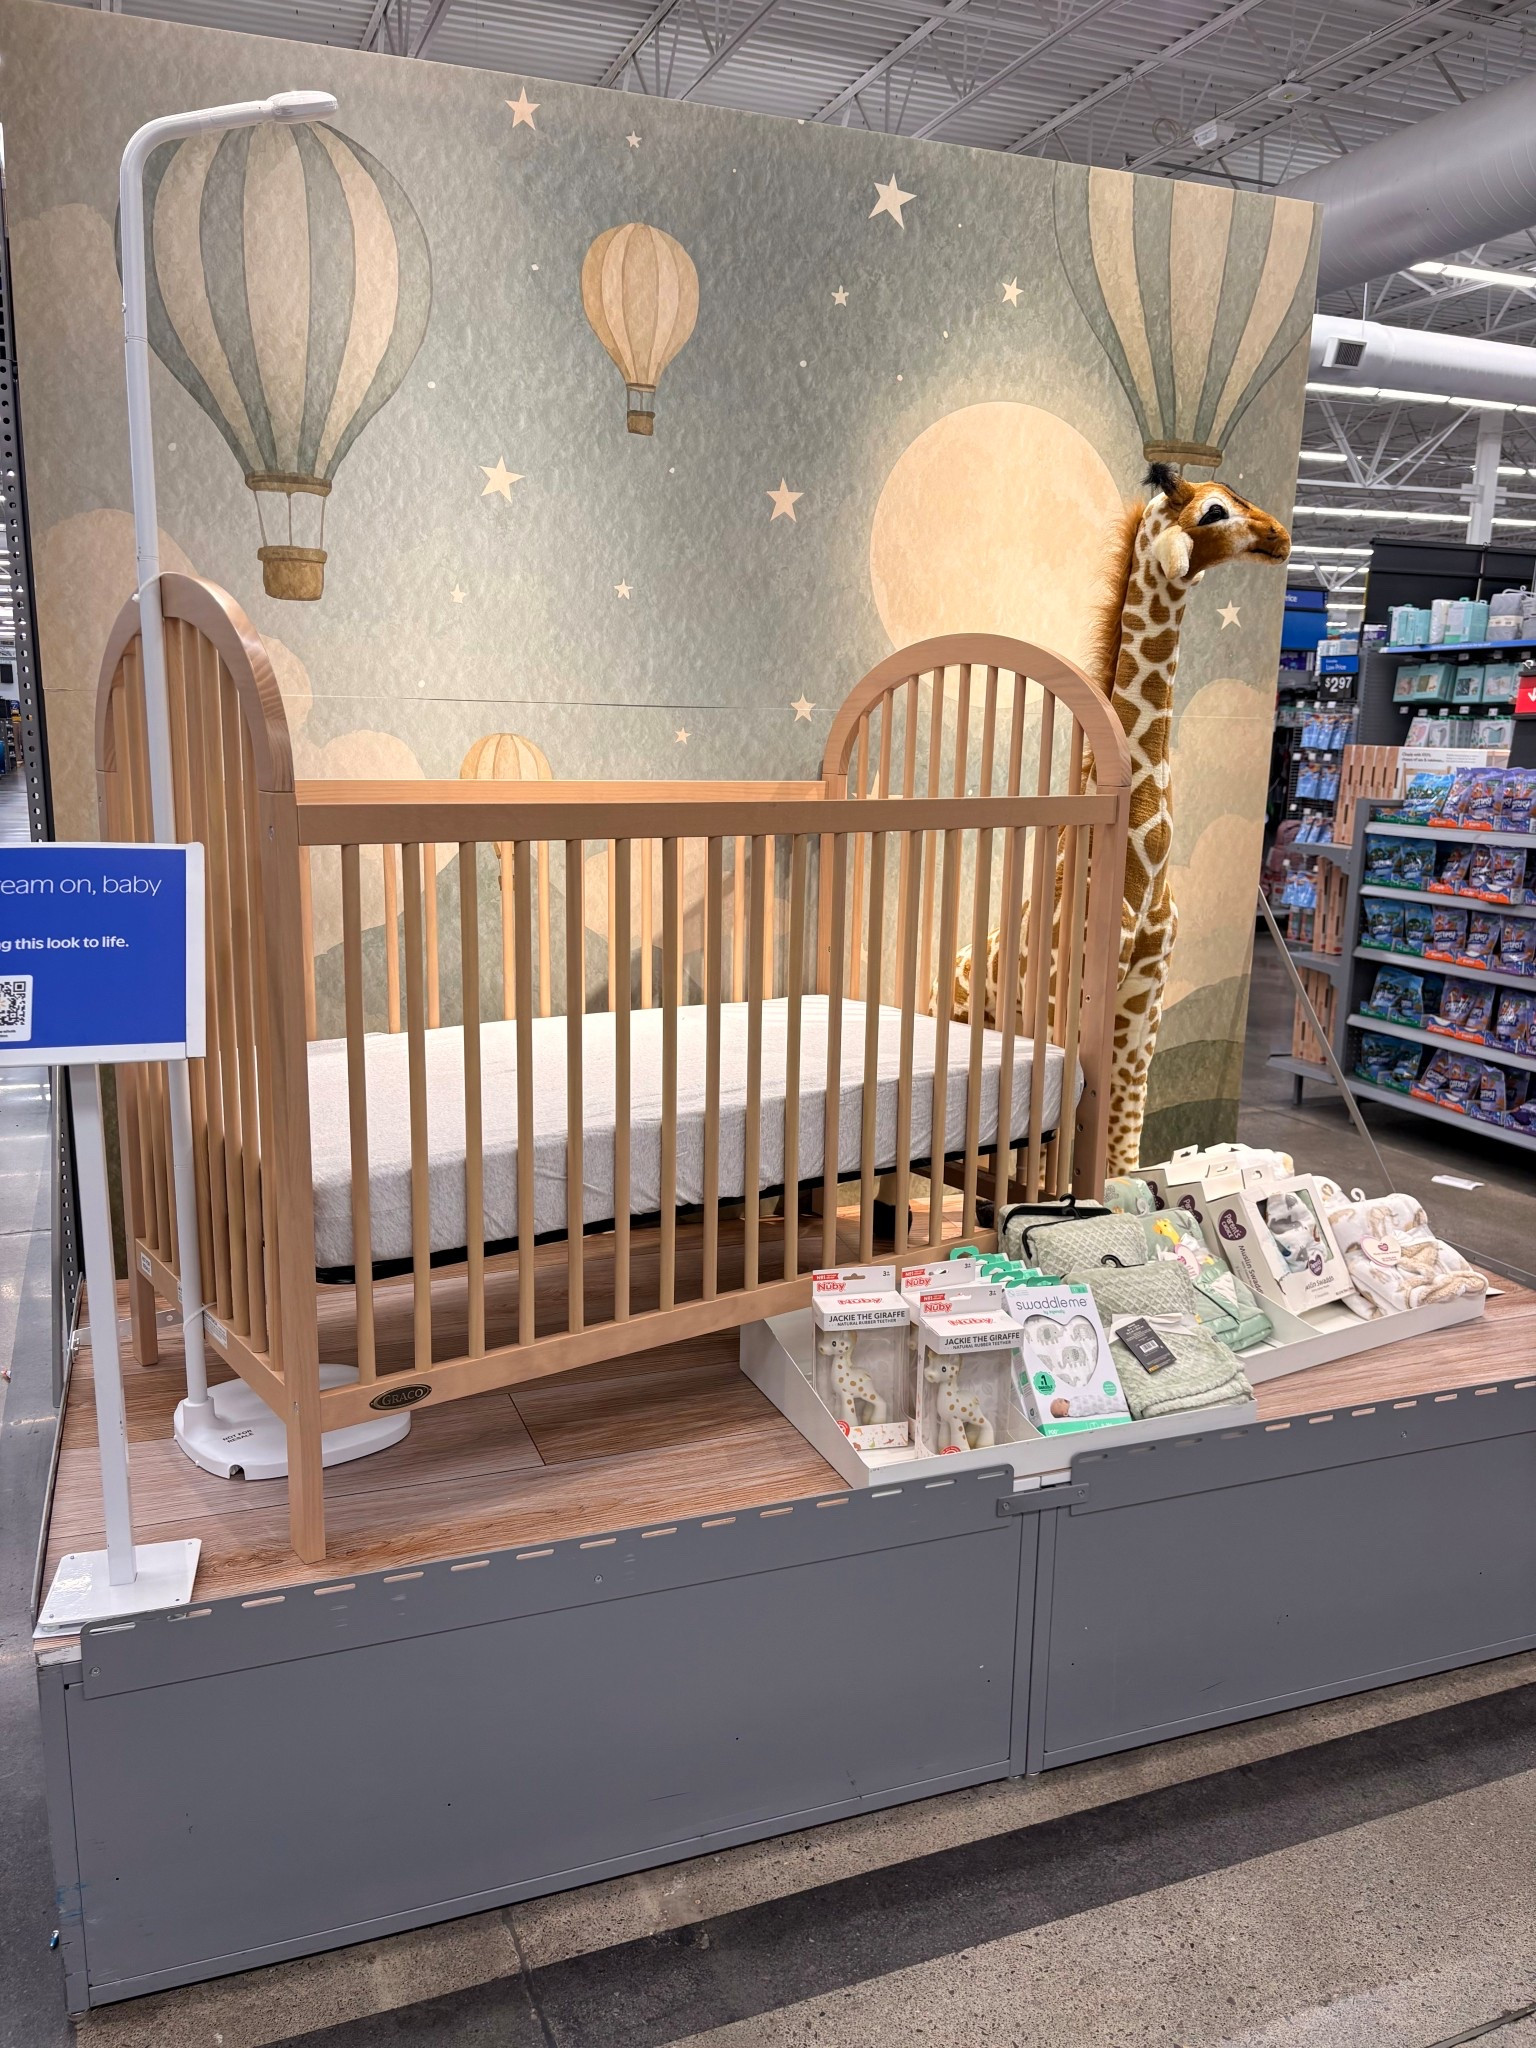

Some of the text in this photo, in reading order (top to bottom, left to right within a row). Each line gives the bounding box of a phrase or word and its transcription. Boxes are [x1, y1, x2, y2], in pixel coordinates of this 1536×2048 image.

[59, 878, 97, 896] on,
[103, 875, 162, 897] baby
[15, 938, 44, 950] this
[46, 936, 81, 949] look
[83, 937, 100, 948] to
[102, 936, 130, 948] life.
[1238, 1245, 1253, 1269] Muslin
[1015, 1295, 1087, 1311] swaddleme
[829, 1310, 906, 1323] JACKIE THE GIRAFFE
[944, 1332, 1020, 1346] JACKIE THE GIRAFFE
[381, 1388, 424, 1406] GRACO
[227, 1432, 254, 1443] RESALE
